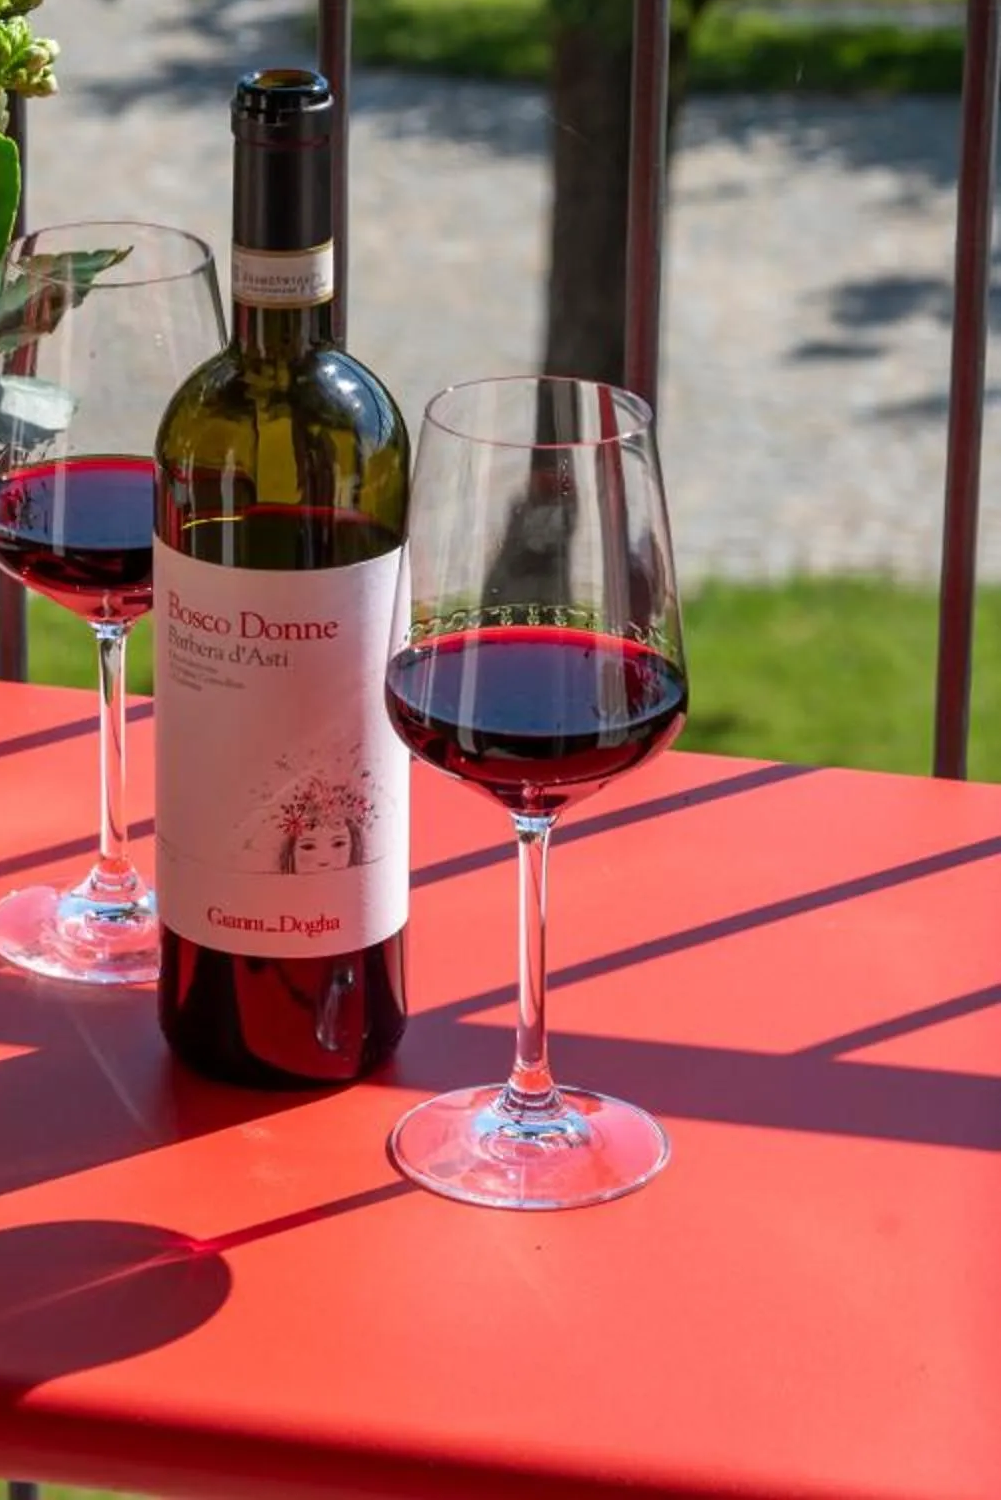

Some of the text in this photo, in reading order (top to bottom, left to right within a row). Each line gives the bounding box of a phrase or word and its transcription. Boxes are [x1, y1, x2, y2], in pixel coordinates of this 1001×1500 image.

[167, 591, 340, 641] Bosco Donne
[168, 625, 224, 661] Barbera
[228, 644, 289, 668] d'Asti
